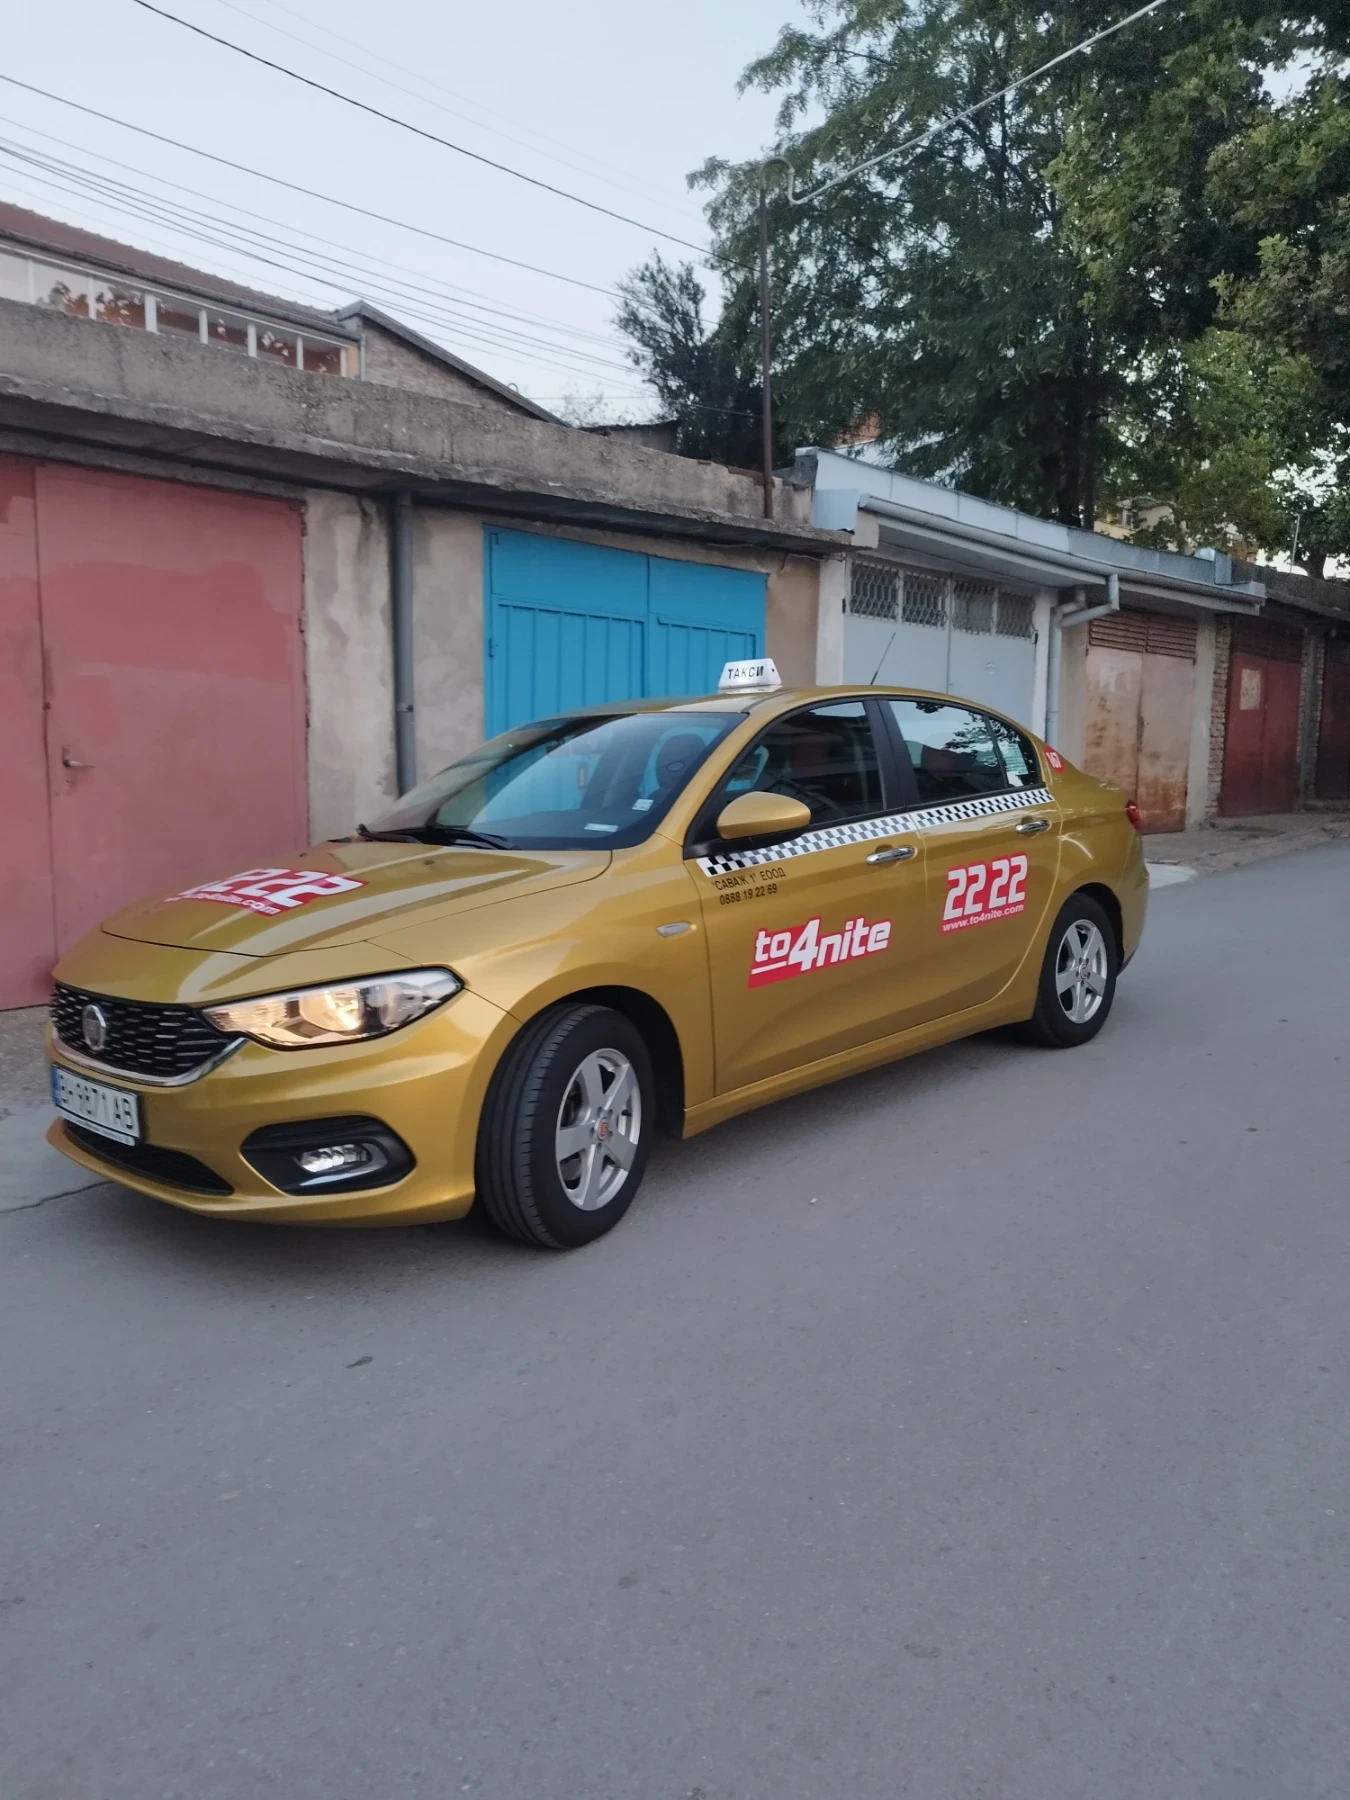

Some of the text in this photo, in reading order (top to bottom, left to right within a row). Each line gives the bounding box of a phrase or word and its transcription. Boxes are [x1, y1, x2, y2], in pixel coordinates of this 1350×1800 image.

[727, 665, 764, 679] ТАКСИ
[759, 867, 786, 881] ЕООД
[719, 883, 778, 906] 0888 19 22 69
[942, 904, 1024, 932] www.to4nite.com
[755, 917, 891, 972] to4nite
